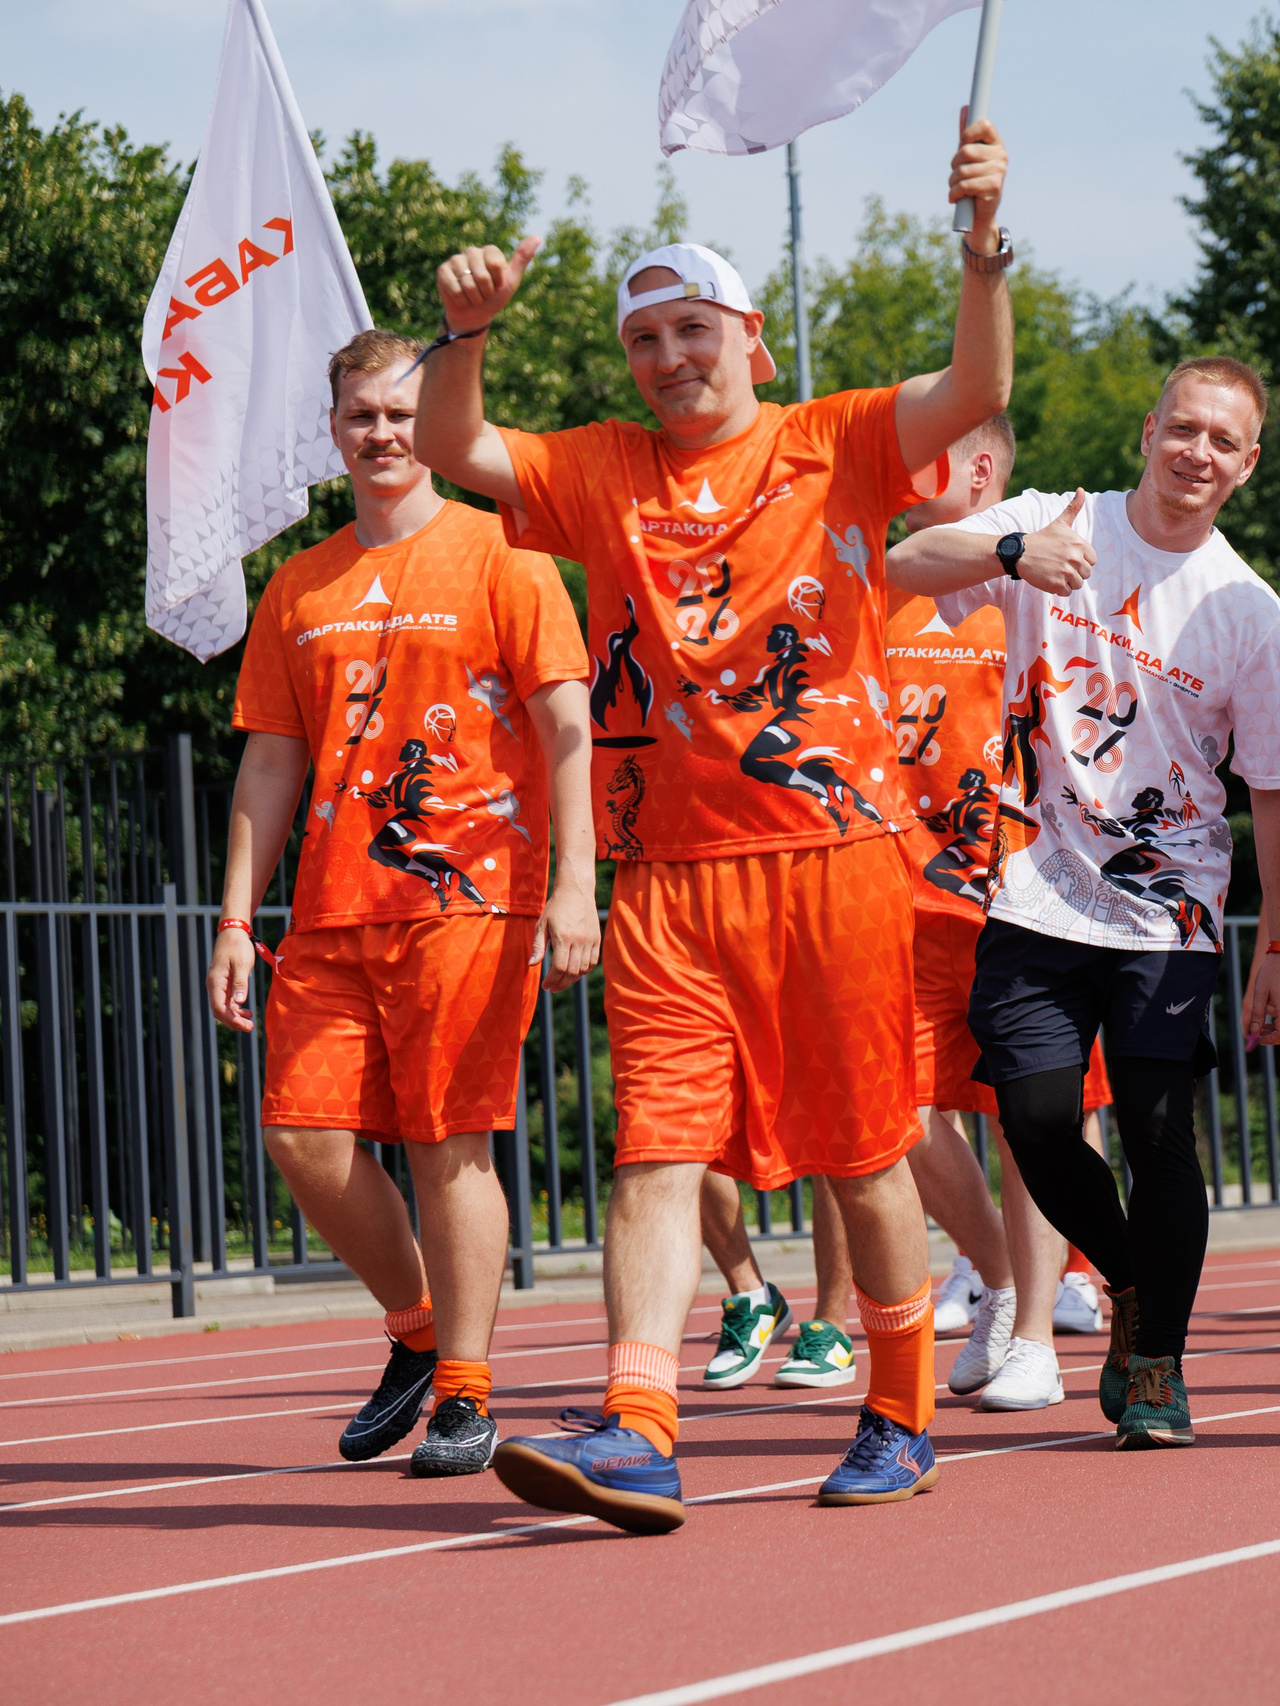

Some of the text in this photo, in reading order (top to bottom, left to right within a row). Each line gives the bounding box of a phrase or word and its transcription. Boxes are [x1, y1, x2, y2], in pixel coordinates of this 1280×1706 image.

[667, 551, 731, 607] 20
[296, 613, 458, 646] СПАРТАКИАДА АТБ
[675, 596, 740, 646] 26
[885, 647, 976, 659] РТАКИАДА
[345, 656, 388, 703] 20
[1076, 671, 1138, 728] 20
[1137, 665, 1169, 683] КОМАНДА
[1172, 682, 1200, 699] ЭНЕРГИЯ
[1166, 666, 1205, 692] АТБ
[344, 697, 385, 746] 26
[896, 683, 947, 724] 20
[895, 724, 942, 767] 26
[1069, 718, 1127, 773] 26
[591, 1452, 652, 1472] DEMIX
